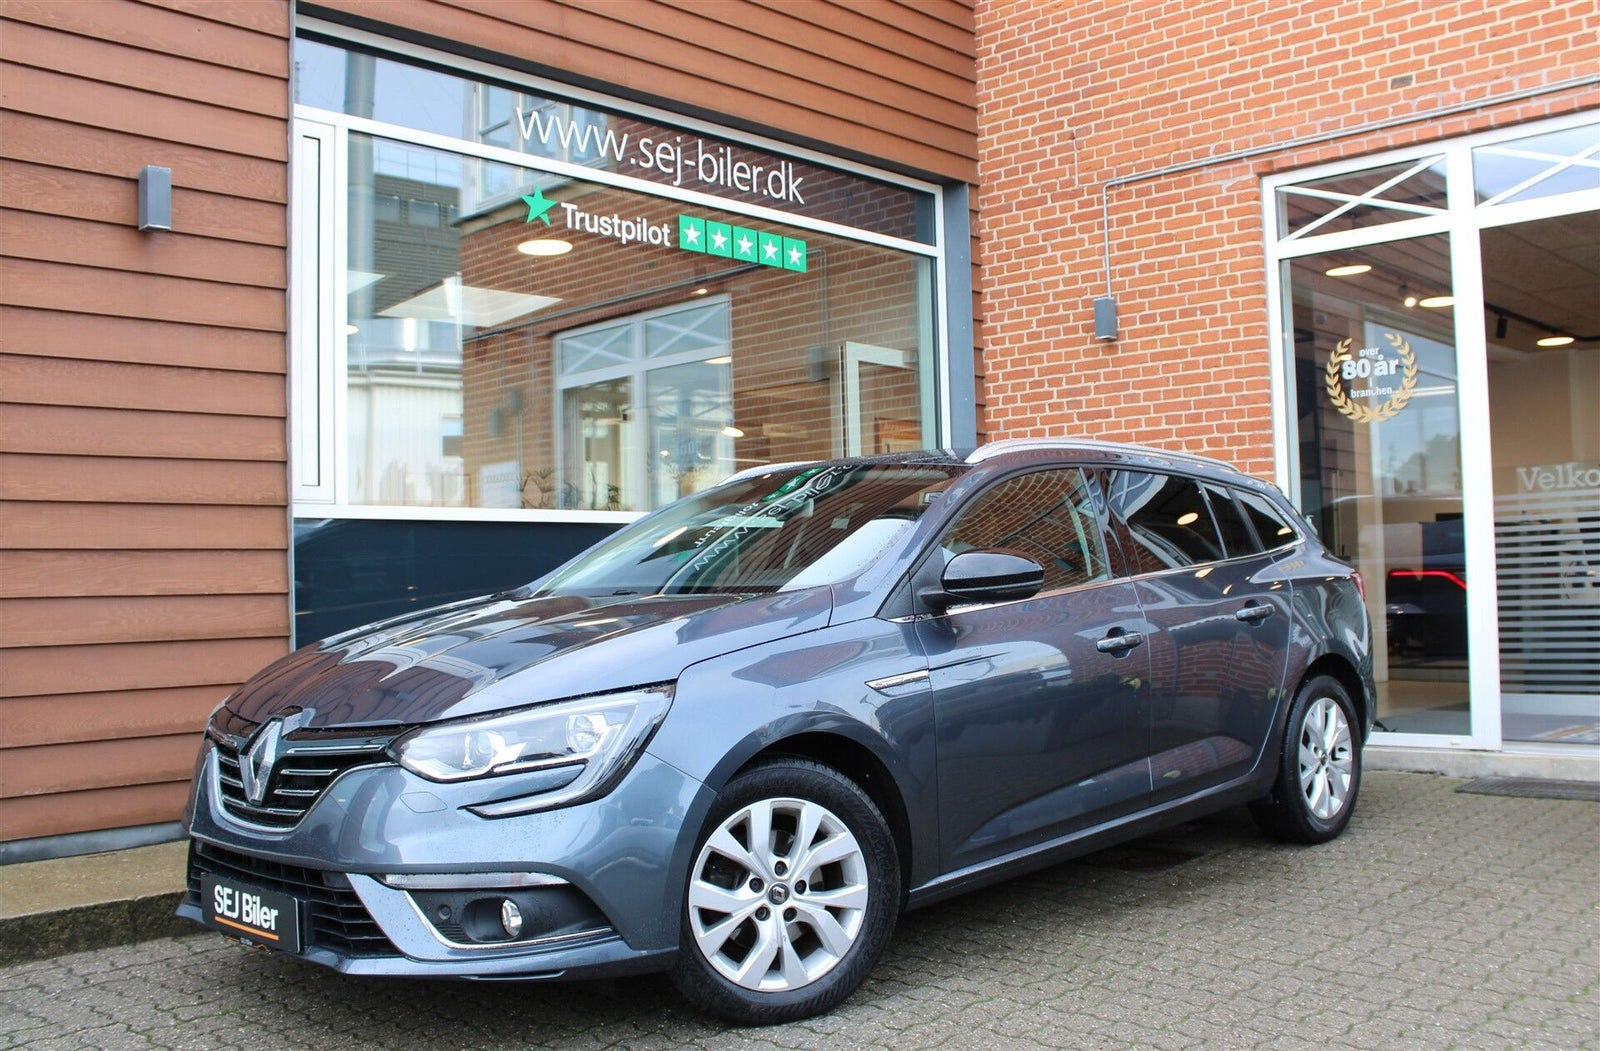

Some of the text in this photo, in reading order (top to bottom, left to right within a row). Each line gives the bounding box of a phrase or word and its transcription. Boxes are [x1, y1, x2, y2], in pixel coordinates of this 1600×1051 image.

[516, 107, 805, 204] www.sej-biler.dk
[560, 202, 671, 247] Trustpilot
[1342, 354, 1399, 380] 80 år
[1360, 347, 1379, 357] over
[214, 884, 279, 931] SEJ Biler
